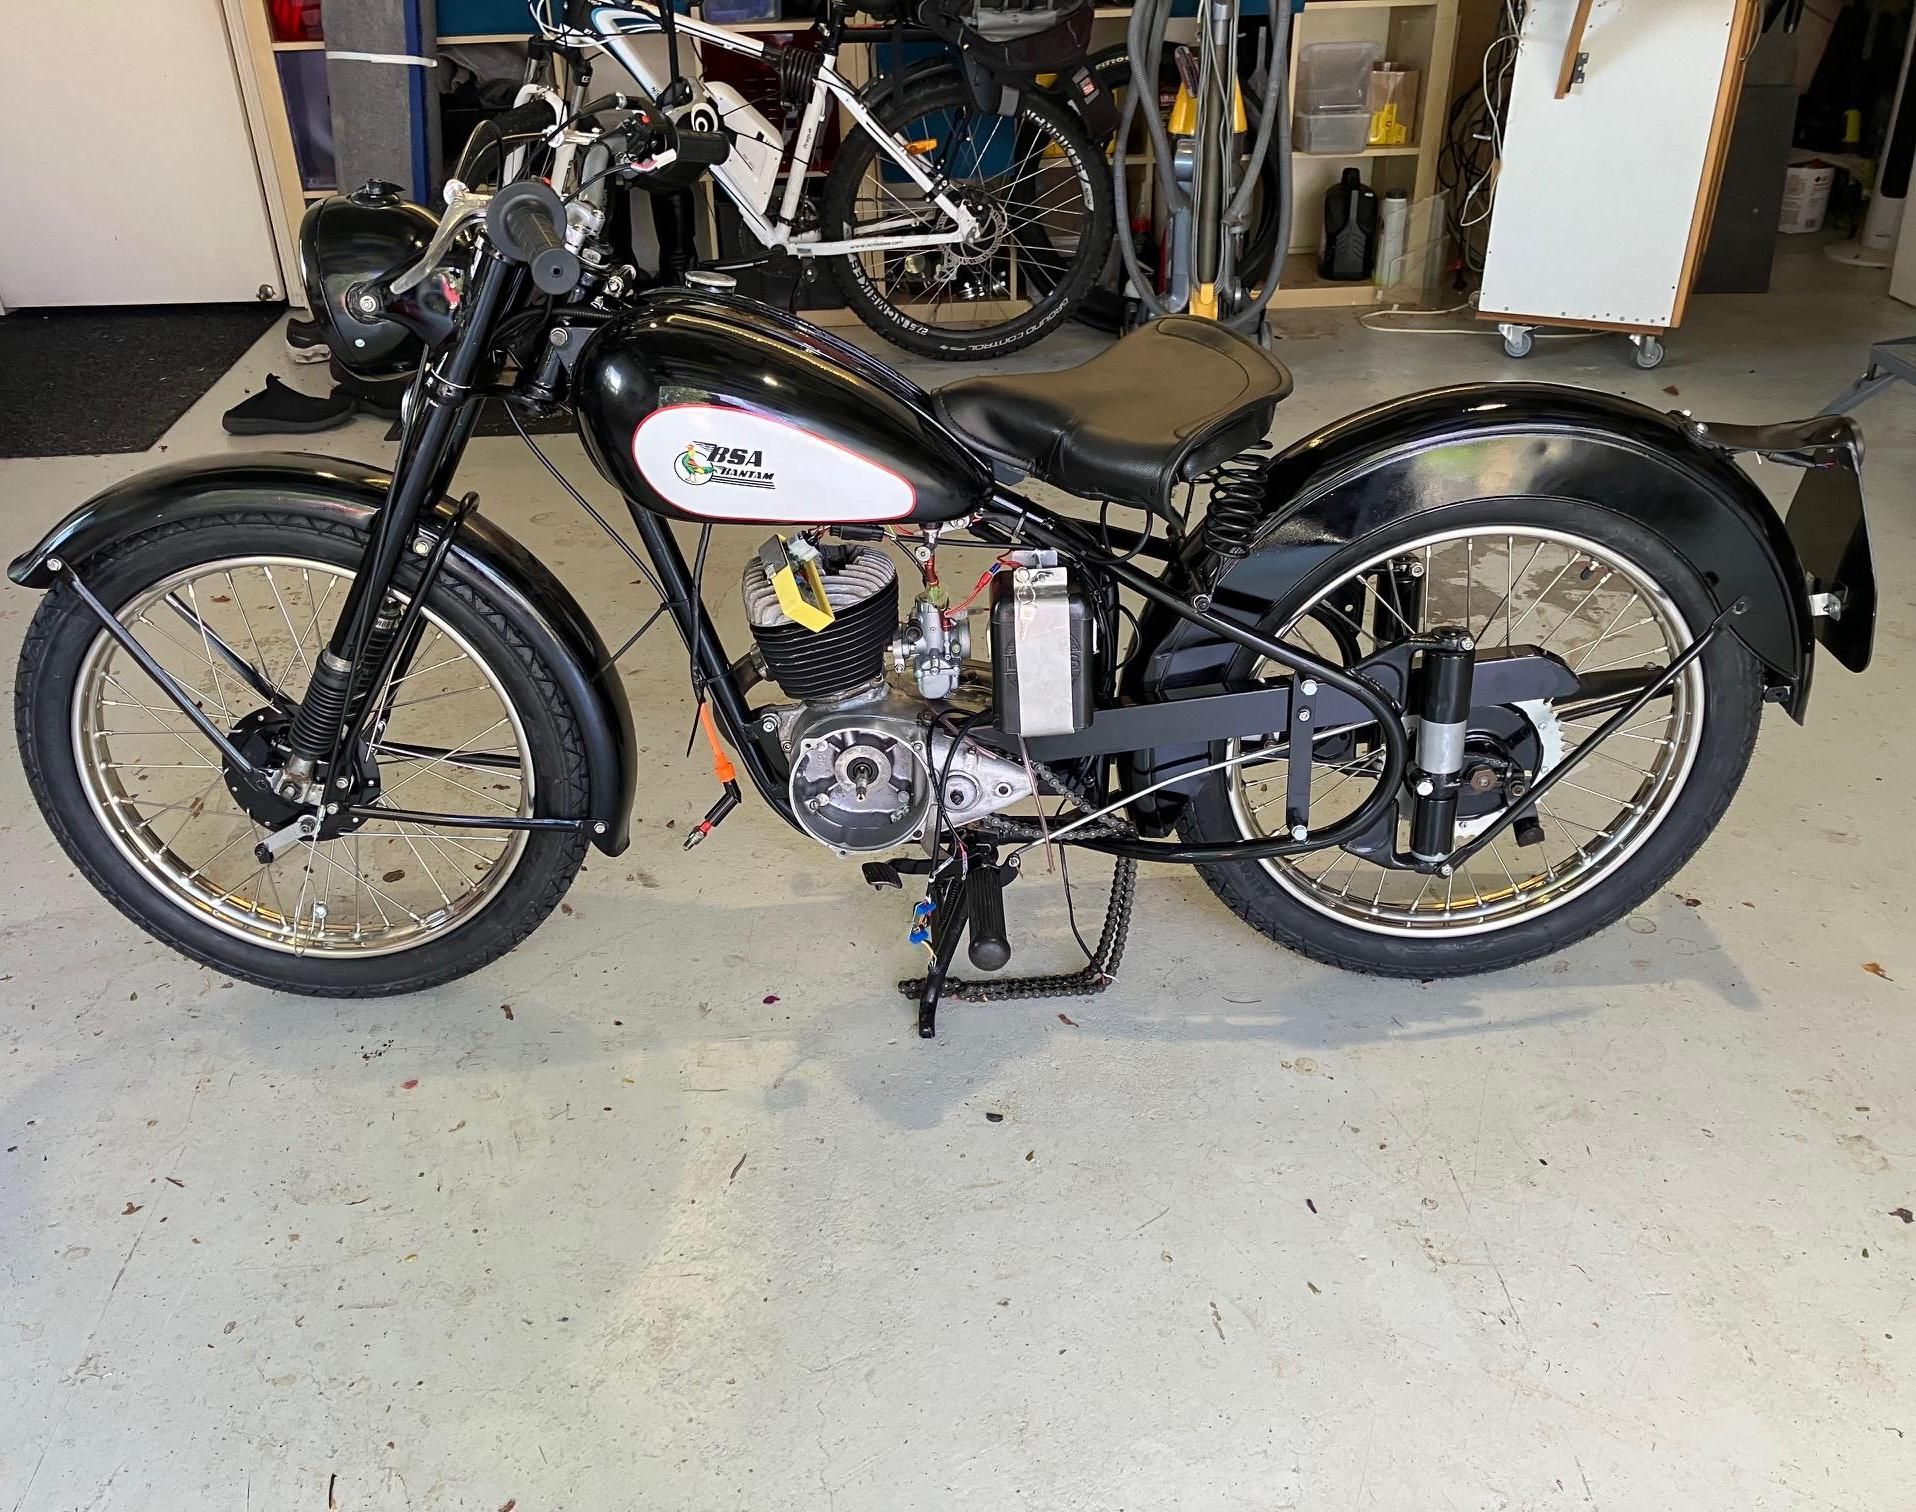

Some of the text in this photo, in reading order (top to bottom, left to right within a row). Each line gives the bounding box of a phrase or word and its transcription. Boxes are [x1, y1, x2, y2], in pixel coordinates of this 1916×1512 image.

[968, 297, 1069, 352] GROUND CONTROL
[700, 443, 763, 468] BSA
[717, 467, 775, 480] BANTAM
